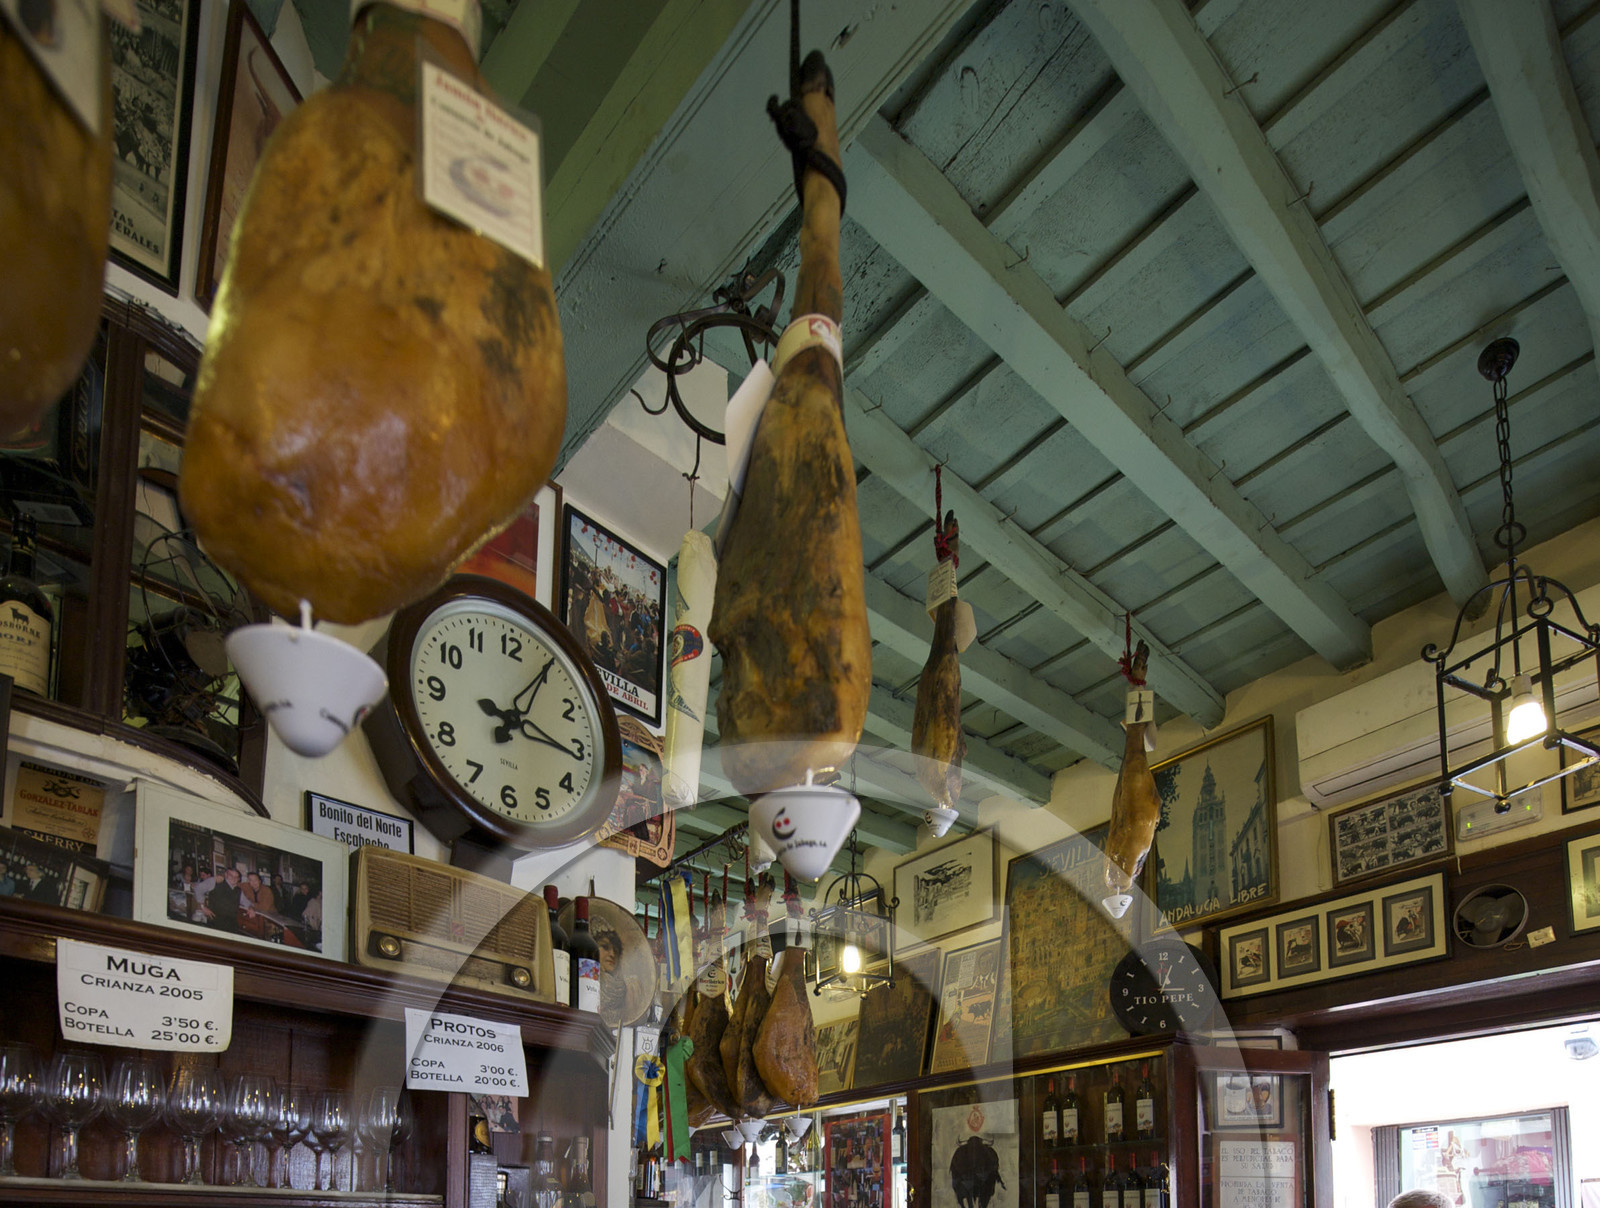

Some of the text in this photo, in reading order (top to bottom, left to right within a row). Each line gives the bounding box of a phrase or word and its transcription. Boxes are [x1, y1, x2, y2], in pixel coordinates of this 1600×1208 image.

[440, 641, 463, 670] 10
[469, 627, 523, 662] 11 12
[427, 675, 446, 701] 9
[606, 683, 649, 711] DE ABRIL
[562, 698, 576, 723] 2
[437, 721, 456, 747] 8
[571, 738, 585, 761] 3
[466, 759, 484, 783] 7
[559, 772, 575, 794] 4
[500, 785, 551, 810] 6 5
[320, 802, 402, 838] Bonito del Norte
[107, 955, 181, 981] MUGA
[1159, 952, 1168, 961] 12
[80, 974, 203, 1001] CRIANZA 2005
[1122, 984, 1205, 996] 9 3
[1134, 993, 1194, 1005] TIO PEPE
[64, 1002, 109, 1019] COPA
[161, 1016, 200, 1030] 3'50
[431, 1018, 497, 1039] PROTOS
[1160, 1020, 1166, 1029] 6
[64, 1017, 135, 1038] BOTELLA
[151, 1030, 200, 1044] 25'00
[424, 1034, 504, 1053] CRIANZA 2006
[411, 1058, 445, 1069] COPA
[480, 1065, 505, 1075] 3'00
[411, 1070, 464, 1083] BOTELLA
[474, 1076, 507, 1087] 20'00
